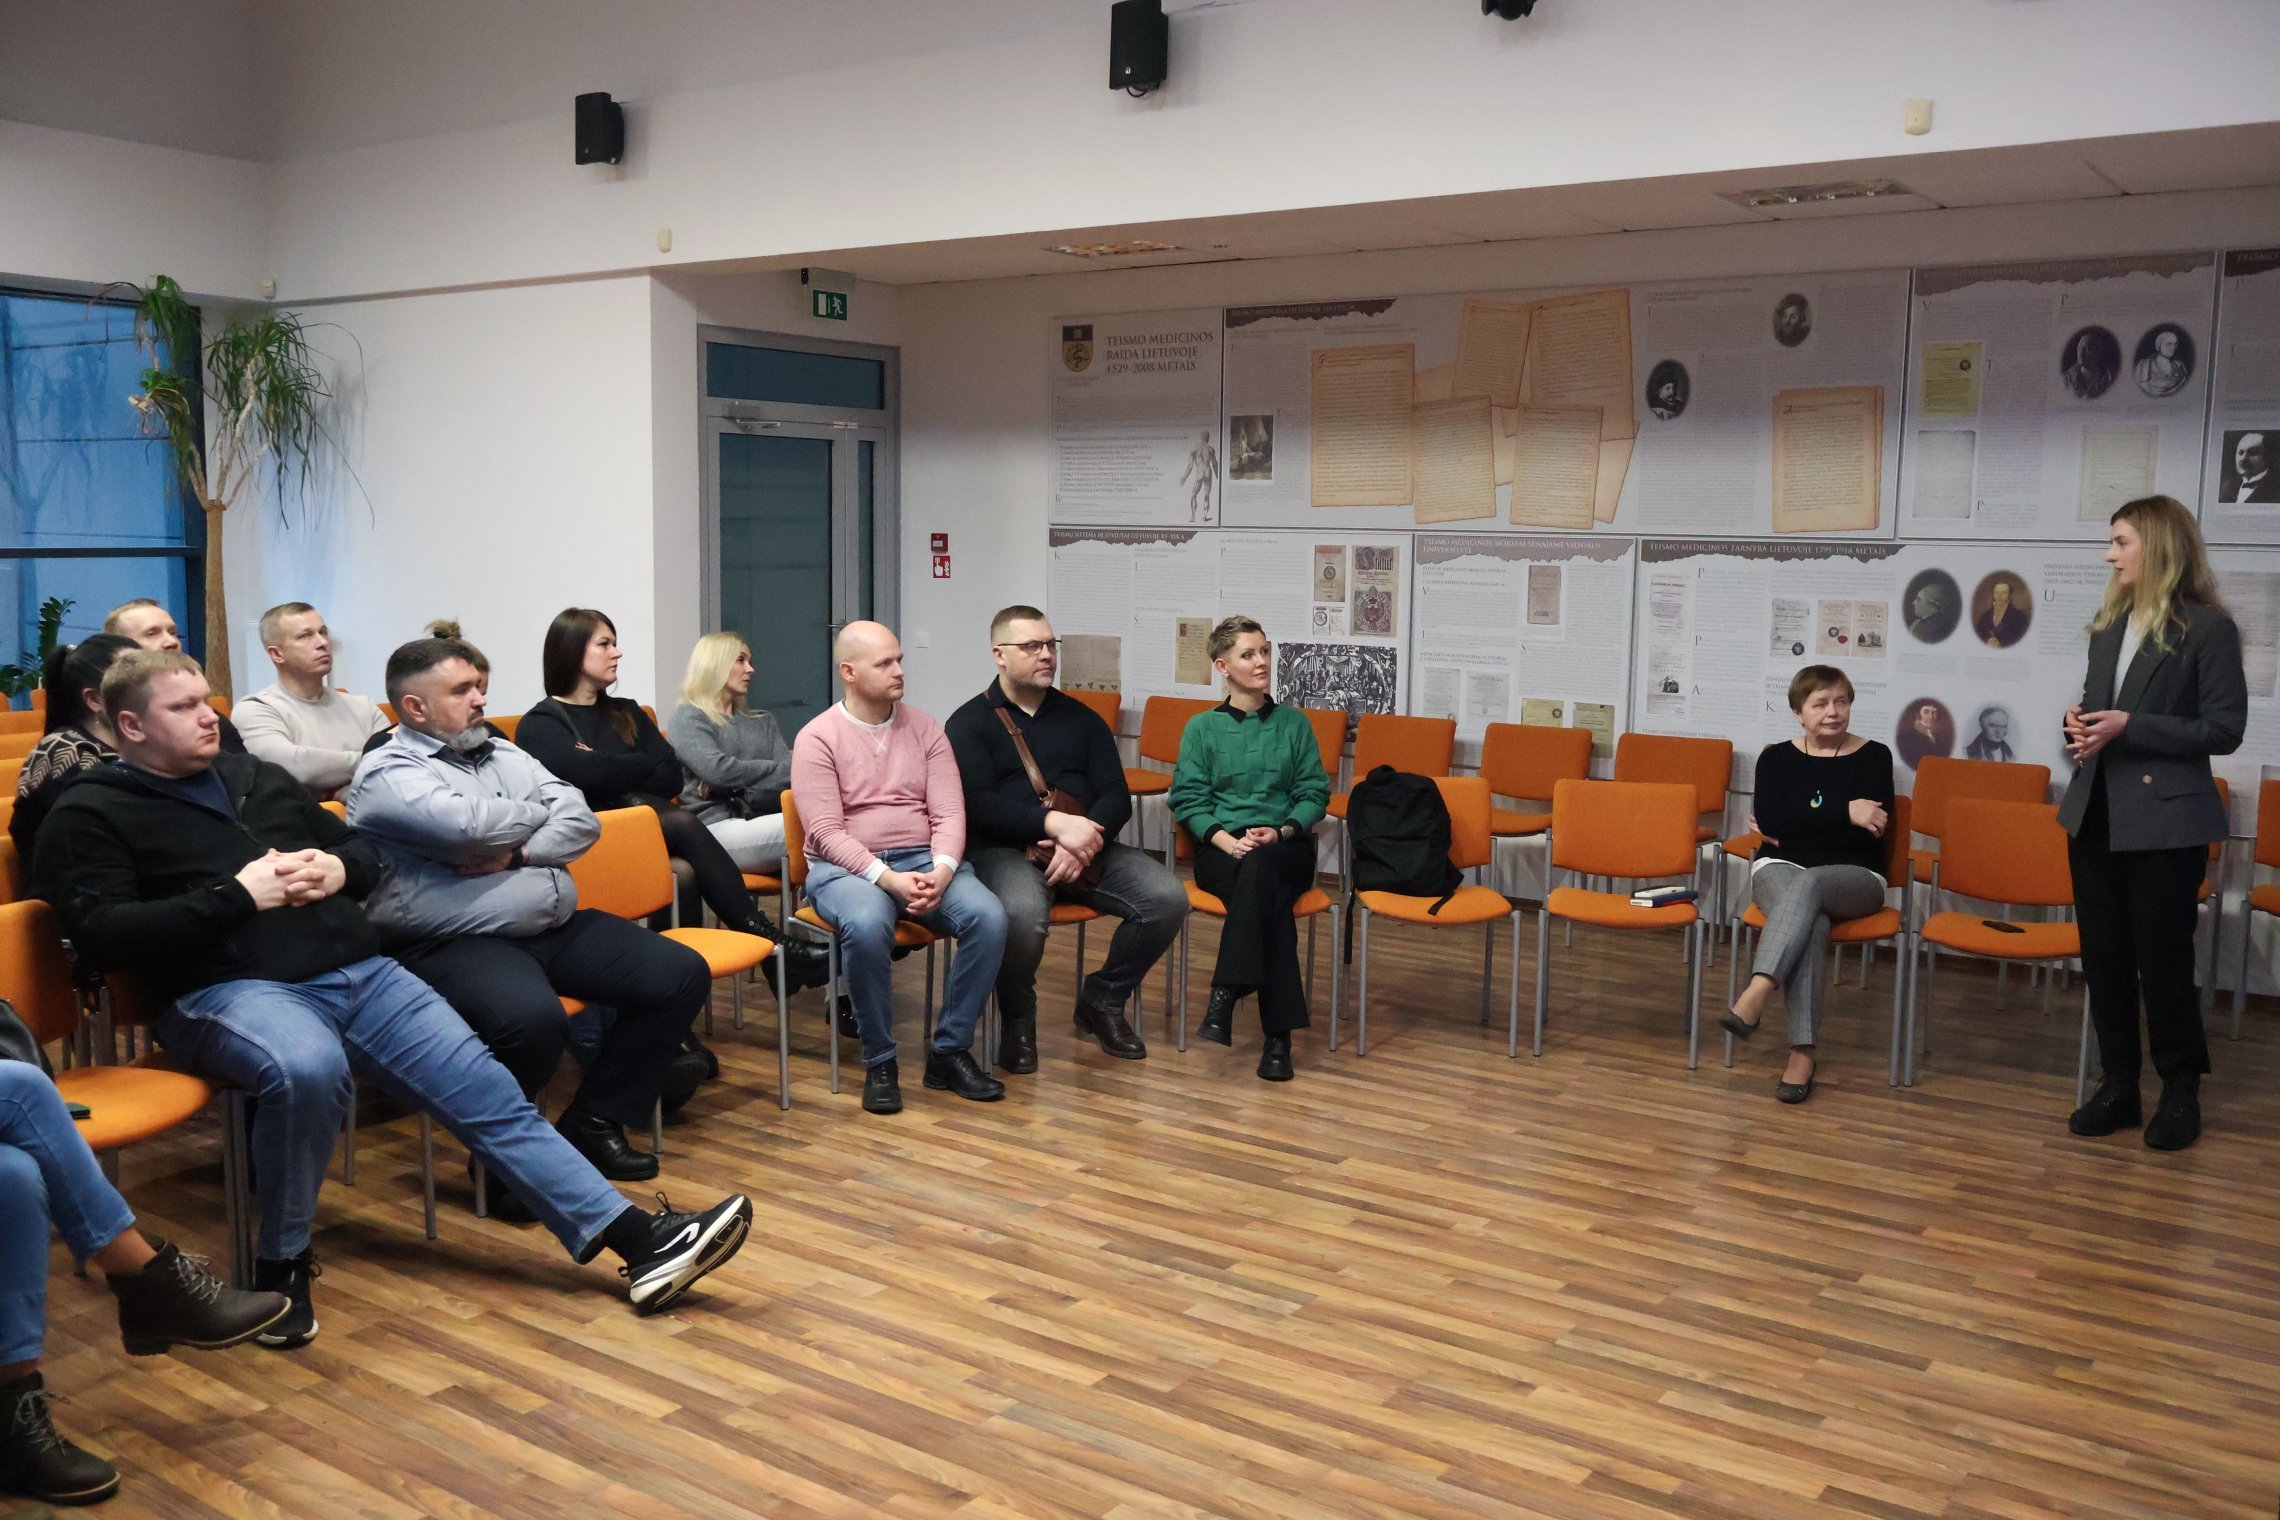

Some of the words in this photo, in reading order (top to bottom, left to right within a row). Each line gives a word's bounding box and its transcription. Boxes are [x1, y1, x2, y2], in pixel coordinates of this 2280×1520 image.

[1106, 334, 1146, 346] TEISMO
[1150, 331, 1214, 344] MEDICINOS
[1106, 349, 1139, 360] RAIDA
[1142, 346, 1198, 359] LIETUVOJE
[1157, 360, 1196, 372] METAIS
[1423, 537, 1450, 546] TEISMO
[1450, 539, 1492, 547] MEDICINOS
[1650, 543, 1679, 551] TEISMO
[1681, 543, 1728, 552] MEDICINOS
[1730, 544, 1768, 553] TARNYBA
[1769, 545, 1812, 554] LIETUVOJE
[1855, 547, 1886, 555] METAIS
